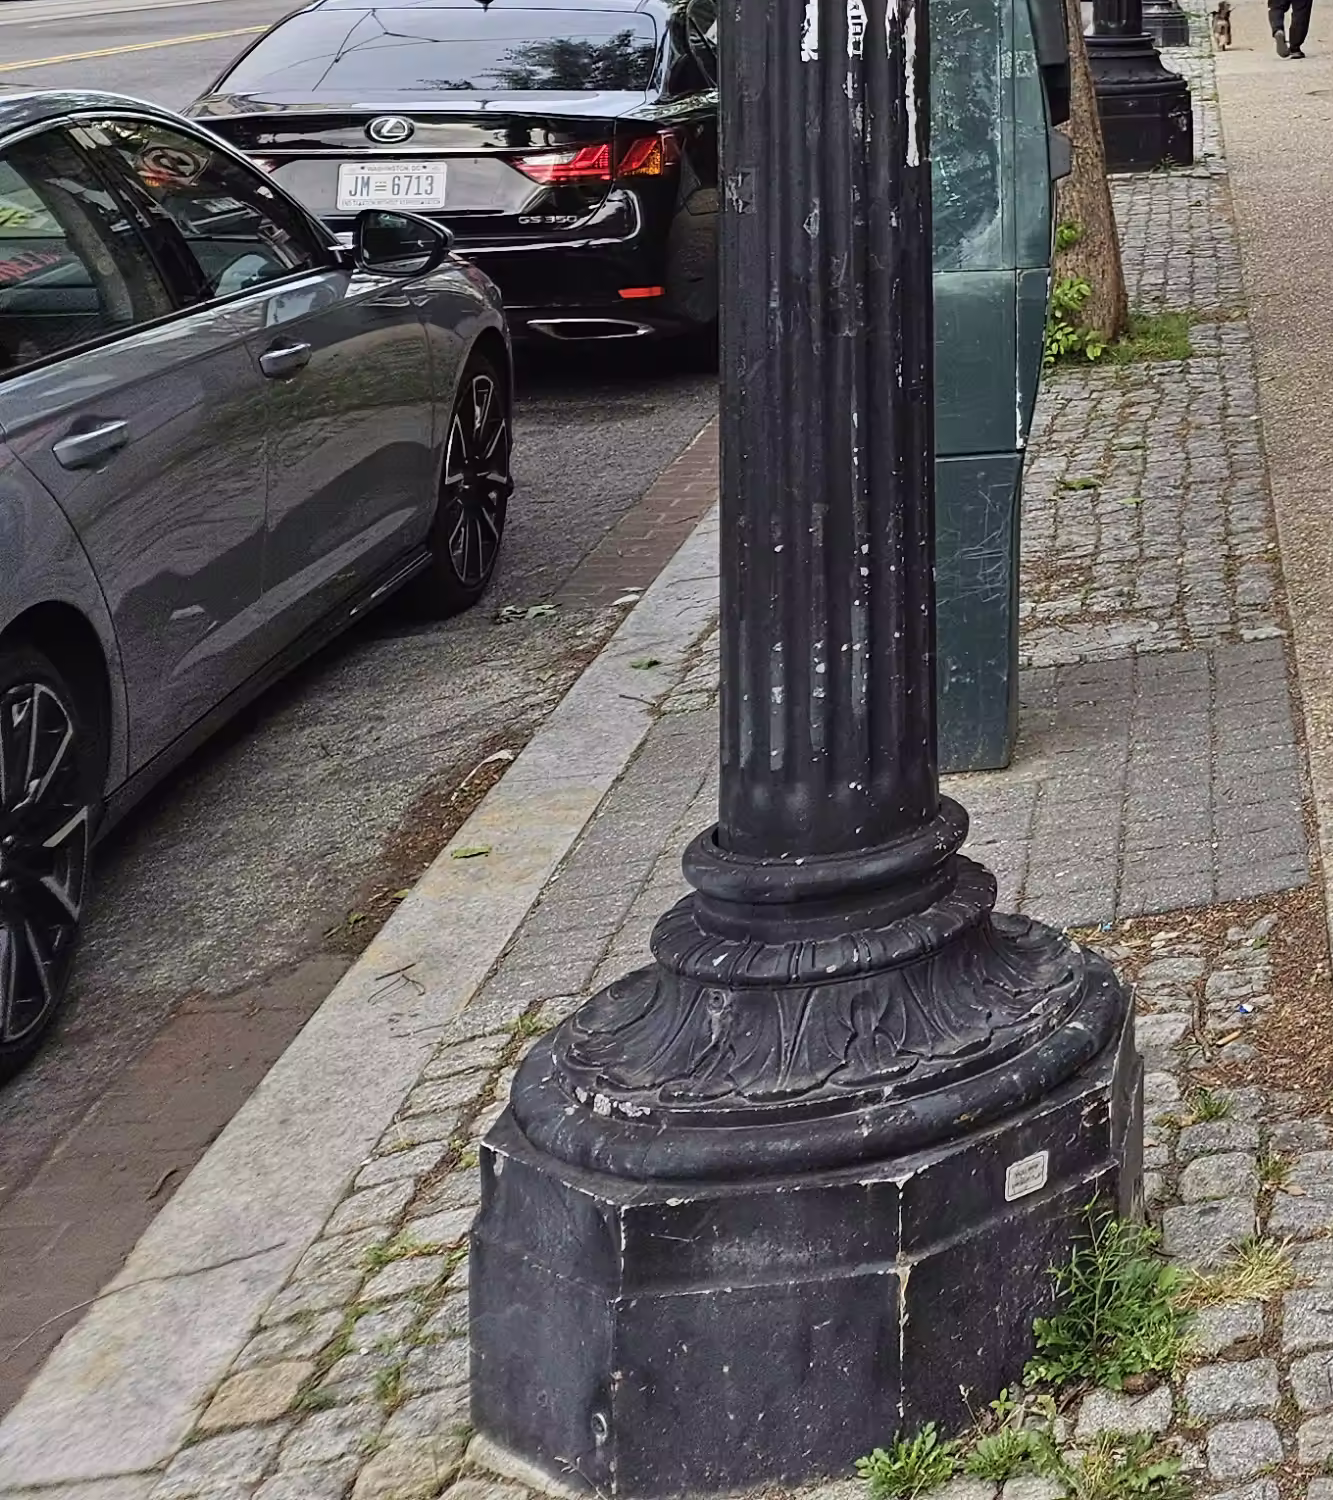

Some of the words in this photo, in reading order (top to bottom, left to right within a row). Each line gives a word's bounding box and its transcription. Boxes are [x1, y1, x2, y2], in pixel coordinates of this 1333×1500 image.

[349, 176, 370, 196] JM
[392, 175, 434, 196] 6713
[518, 216, 542, 224] GS
[545, 215, 578, 224] 350
